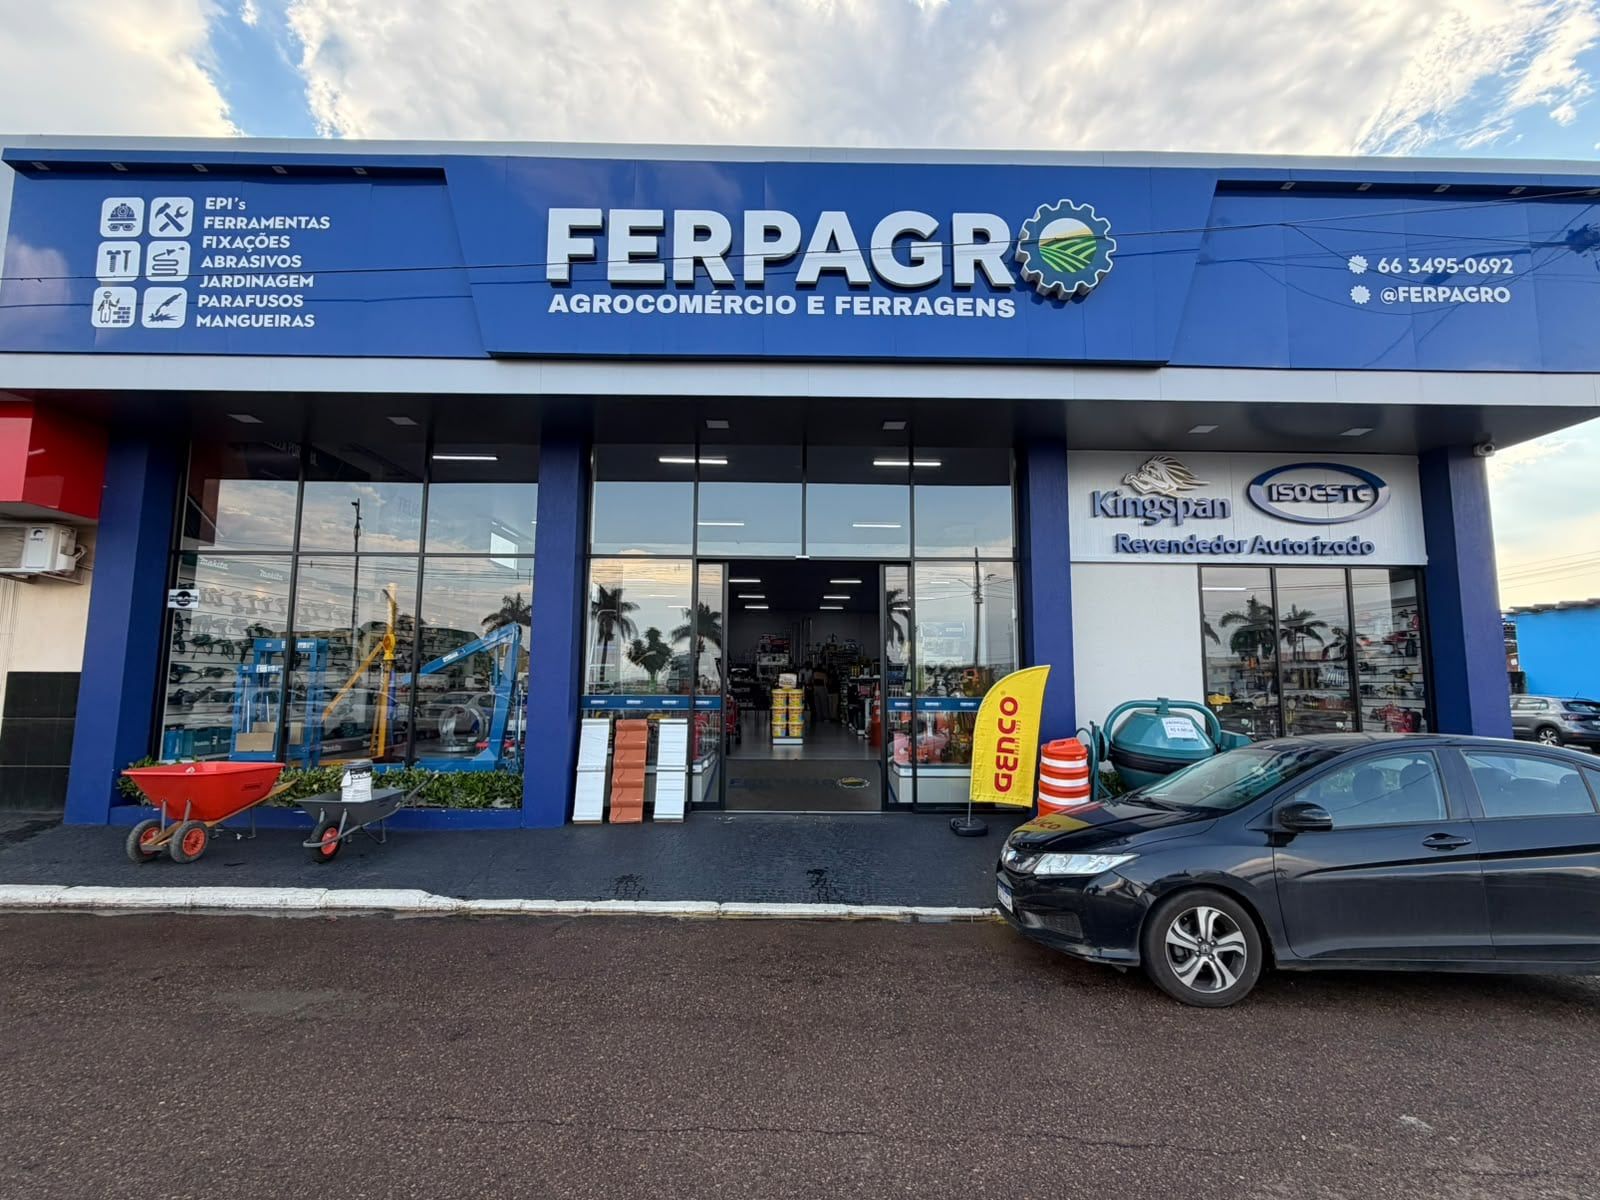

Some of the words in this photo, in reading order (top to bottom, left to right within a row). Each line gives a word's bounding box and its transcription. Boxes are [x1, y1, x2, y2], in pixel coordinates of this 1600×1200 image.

[205, 197, 246, 210] EPI's
[203, 216, 331, 229] FERRAMENTAS
[202, 232, 291, 253] FIXAÇÕES
[200, 255, 303, 269] ABRASIVOS
[1377, 257, 1403, 274] 66
[1407, 257, 1514, 274] 3495-0692
[199, 275, 315, 288] JARDINAGEM
[197, 294, 305, 308] PARAFUSOS
[1380, 286, 1512, 304] @FERPAGRO
[547, 290, 796, 316] AGROCOMÉRCIO
[806, 297, 825, 315] E
[834, 297, 1017, 319] FERRAGENS
[196, 314, 316, 328] MANGUEIRAS
[1268, 483, 1373, 503] ISOESTE
[1091, 489, 1232, 527] Kingspan
[1115, 533, 1247, 555] Revendedor
[1250, 535, 1376, 556] Autorizado
[994, 696, 1019, 793] GENCO
